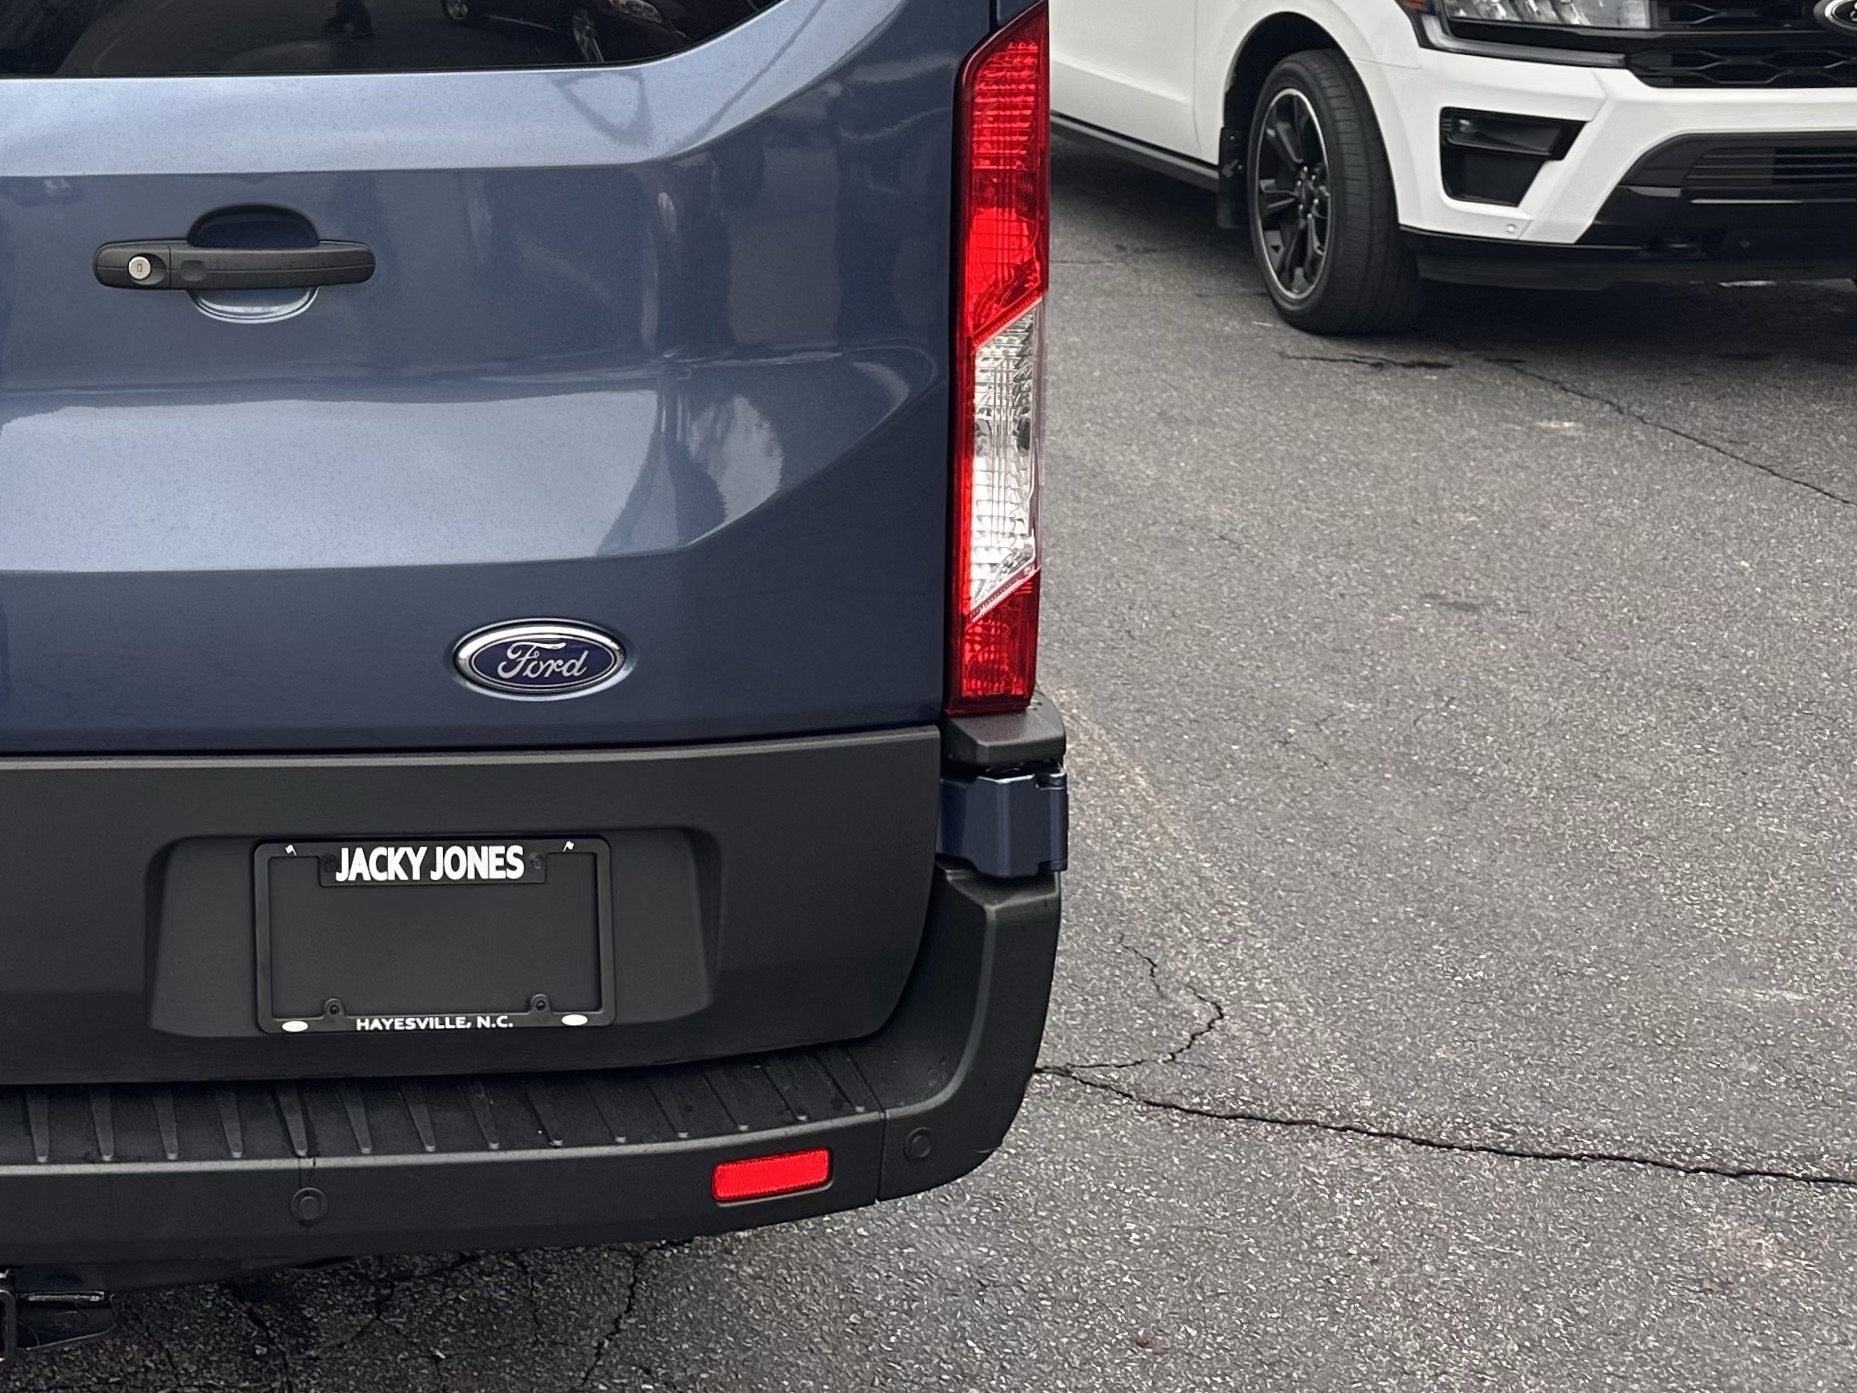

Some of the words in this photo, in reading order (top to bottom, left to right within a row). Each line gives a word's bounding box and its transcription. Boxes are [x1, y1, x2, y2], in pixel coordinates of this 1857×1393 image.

[497, 641, 590, 679] Ford
[335, 846, 428, 882] JACKY
[430, 844, 525, 881] JONES
[356, 1016, 472, 1031] HAYESVILLE,
[476, 1015, 514, 1029] N.C.
